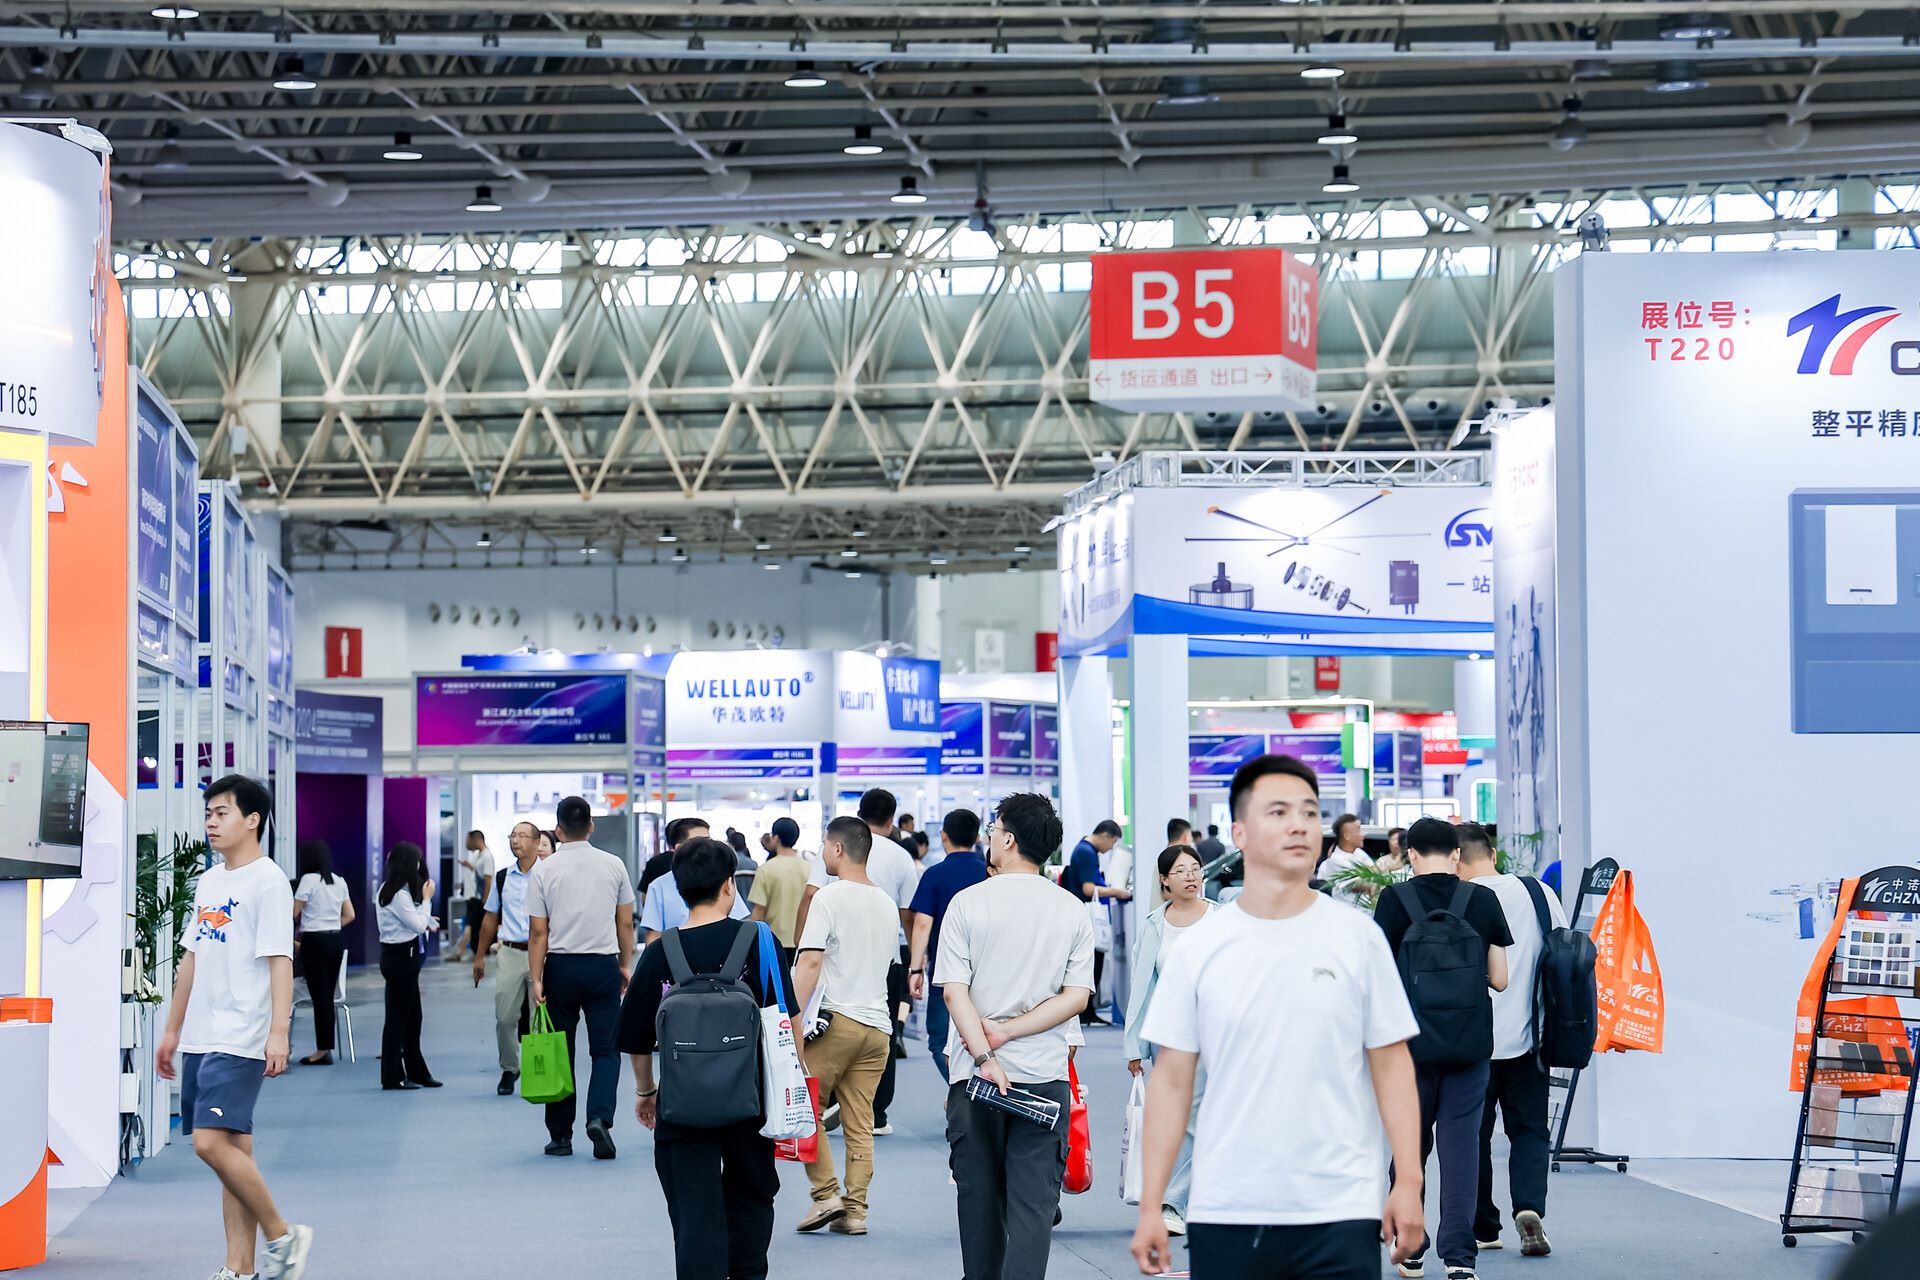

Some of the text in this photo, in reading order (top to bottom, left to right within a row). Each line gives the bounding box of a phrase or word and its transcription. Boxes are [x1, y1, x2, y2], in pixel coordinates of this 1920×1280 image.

[1132, 269, 1235, 340] B5
[1287, 274, 1310, 349] B5
[1645, 338, 1735, 361] T220
[1121, 368, 1248, 389] 货运通道 出口
[0, 382, 37, 416] T185
[1446, 575, 1491, 594] 一站
[1892, 878, 1920, 891] 中诺
